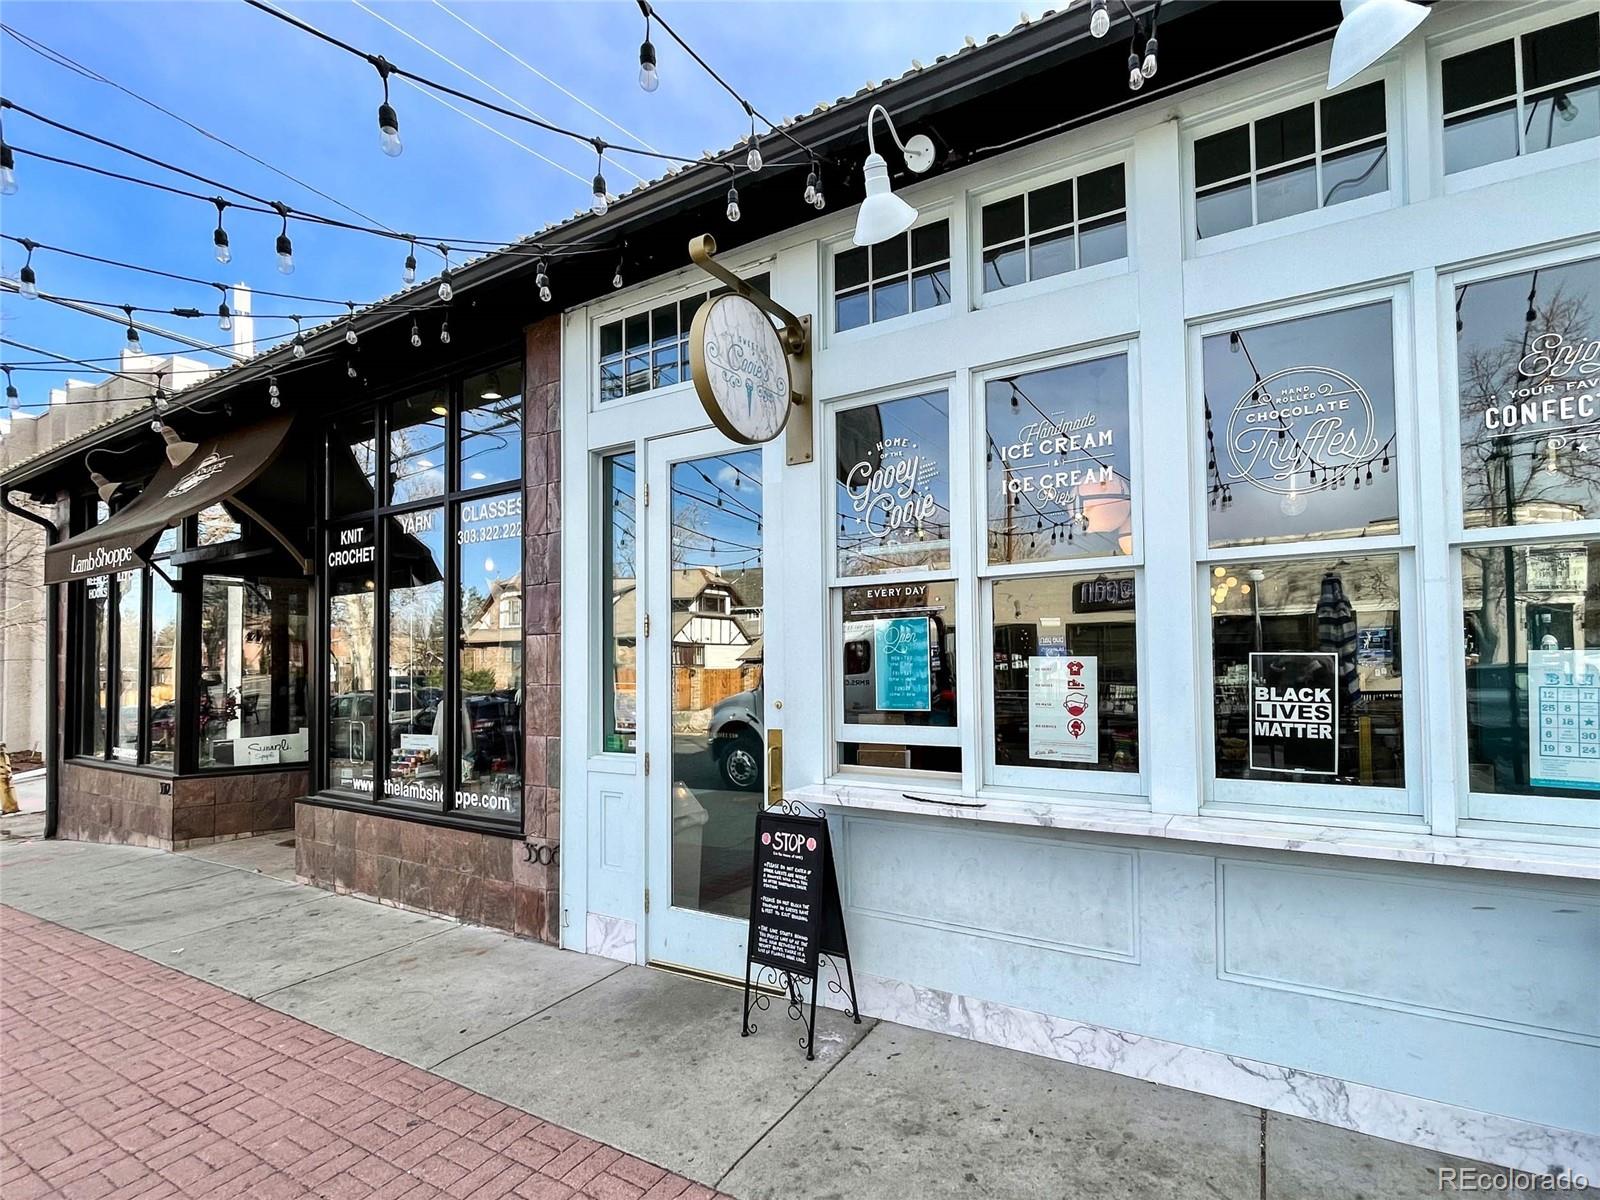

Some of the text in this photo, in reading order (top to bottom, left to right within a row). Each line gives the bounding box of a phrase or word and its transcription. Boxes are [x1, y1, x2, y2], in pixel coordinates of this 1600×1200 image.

[1519, 333, 1600, 376] Enjo
[1275, 393, 1316, 404] ROLLED
[1281, 386, 1310, 395] HAND
[1508, 385, 1554, 398] YOUR
[1246, 400, 1349, 423] CHOCOLATE
[1485, 393, 1600, 429] CONFEC
[1019, 411, 1096, 444] Handmade
[876, 438, 909, 451] HOME
[1002, 430, 1113, 460] ICE CREAM
[1228, 416, 1378, 480] Truffles
[847, 456, 919, 512] Gooey
[1002, 466, 1113, 494] ICE CREAM
[462, 497, 522, 522] CLASSES
[866, 493, 937, 537] Cooie
[401, 514, 433, 533] YARN
[340, 527, 364, 545] KNIT
[71, 546, 132, 573] Lamb Shoppe
[328, 546, 375, 567] CROCHET
[867, 586, 926, 598] EVERY DAY
[1255, 686, 1331, 703] BLACK
[1543, 691, 1554, 699] 12
[1583, 692, 1594, 700] 17
[1256, 703, 1331, 721] LIVES
[1542, 704, 1555, 712] 25
[1254, 721, 1333, 740] MATTER
[1545, 717, 1553, 725] 9
[1581, 732, 1597, 740] 30
[1543, 744, 1556, 752] 19
[1582, 746, 1597, 754] 24
[772, 832, 806, 854] STOP
